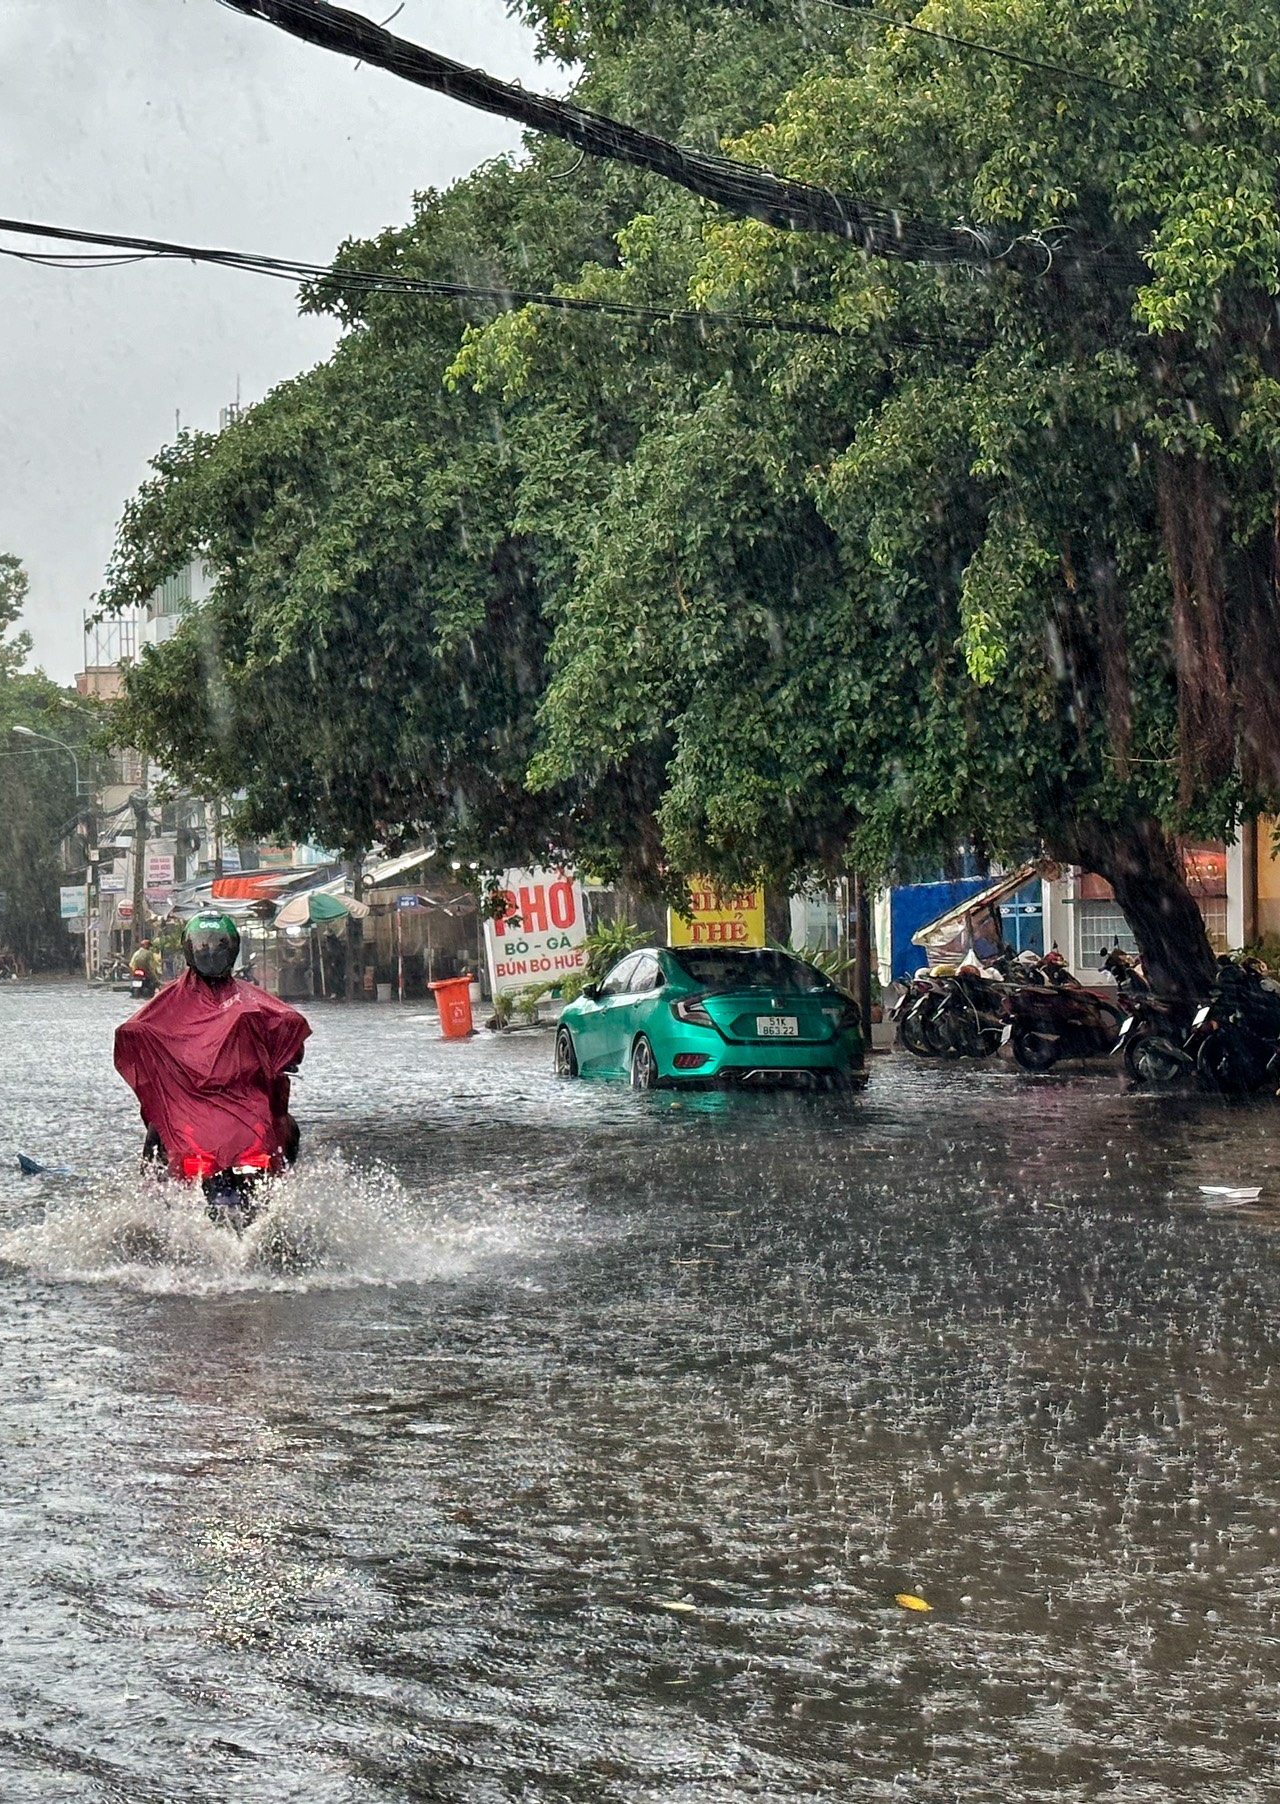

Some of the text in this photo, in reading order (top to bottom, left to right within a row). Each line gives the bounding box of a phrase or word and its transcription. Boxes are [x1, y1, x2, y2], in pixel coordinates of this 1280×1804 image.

[199, 921, 220, 929] Grab
[504, 937, 530, 956] BÒ
[546, 931, 572, 950] GÀ
[495, 948, 585, 977] BÚN BÒ HUẾ
[769, 1017, 787, 1026] 51K
